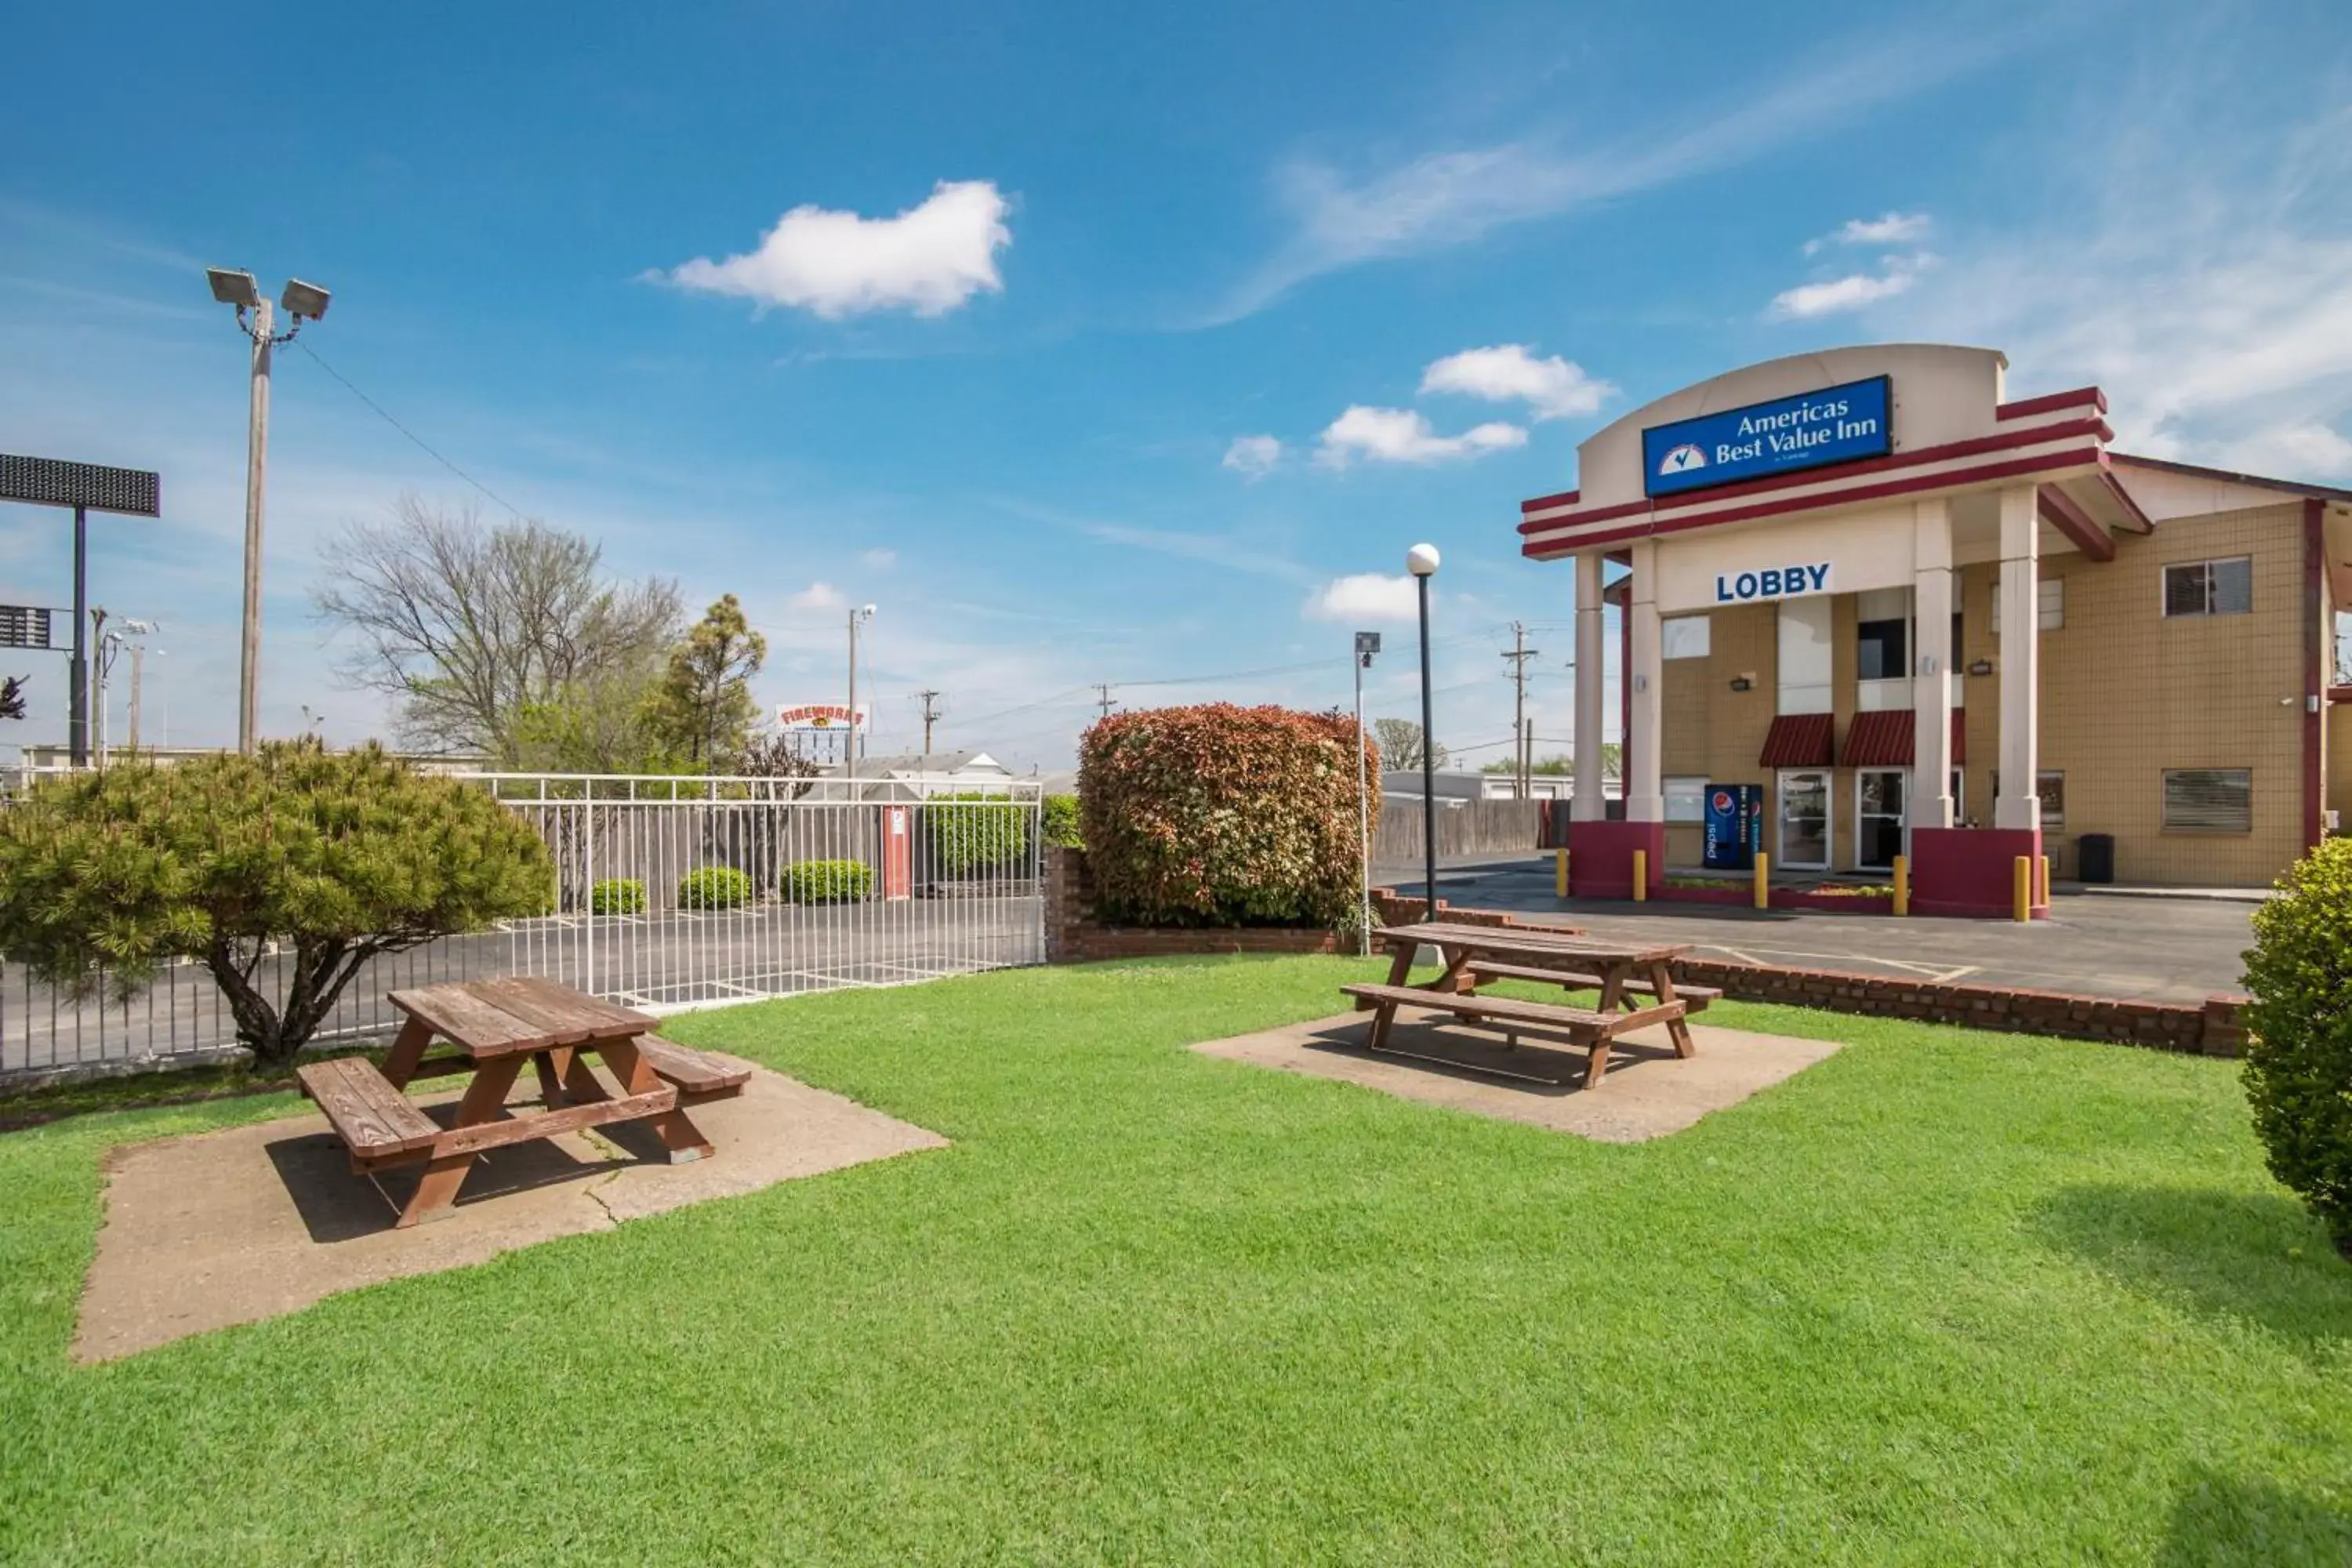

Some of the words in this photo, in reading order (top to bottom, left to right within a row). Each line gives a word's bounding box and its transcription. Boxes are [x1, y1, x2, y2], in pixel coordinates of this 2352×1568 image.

[1737, 400, 1849, 437] Americas
[1716, 438, 1762, 464] Best
[1768, 427, 1831, 452] Value
[1837, 419, 1876, 440] Inn
[1717, 563, 1830, 601] LOBBY
